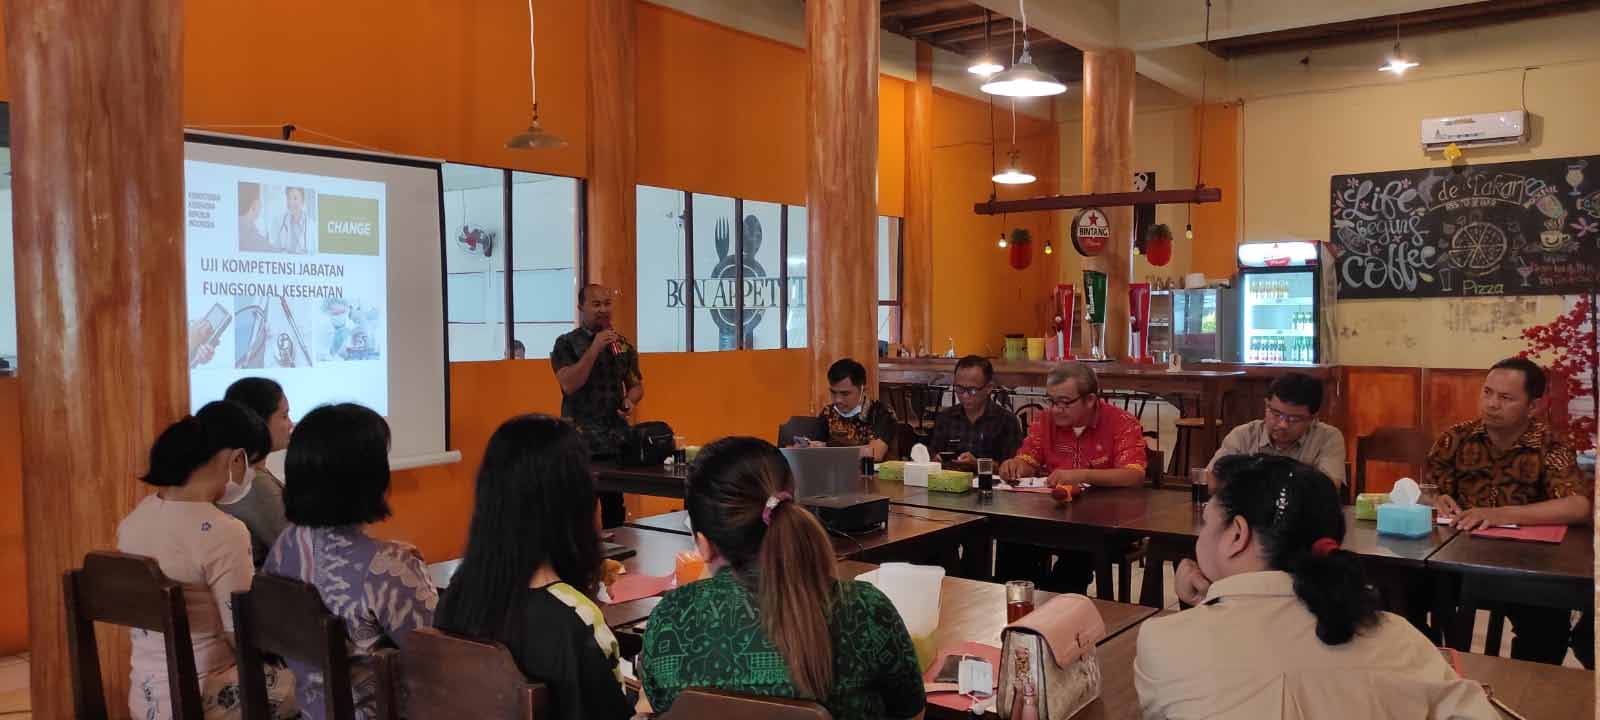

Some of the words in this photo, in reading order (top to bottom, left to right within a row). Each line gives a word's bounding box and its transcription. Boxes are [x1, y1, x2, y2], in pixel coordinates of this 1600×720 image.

[1342, 180, 1418, 220] Life
[328, 220, 371, 236] CHANGE
[1079, 227, 1108, 236] BINTANG
[200, 256, 218, 272] UJI
[222, 258, 295, 276] KOMPETENSI
[298, 263, 344, 278] JABATAN
[202, 281, 280, 297] FUNGSIONAL
[282, 284, 343, 299] KESEHATAN
[1462, 279, 1505, 296] Pizza
